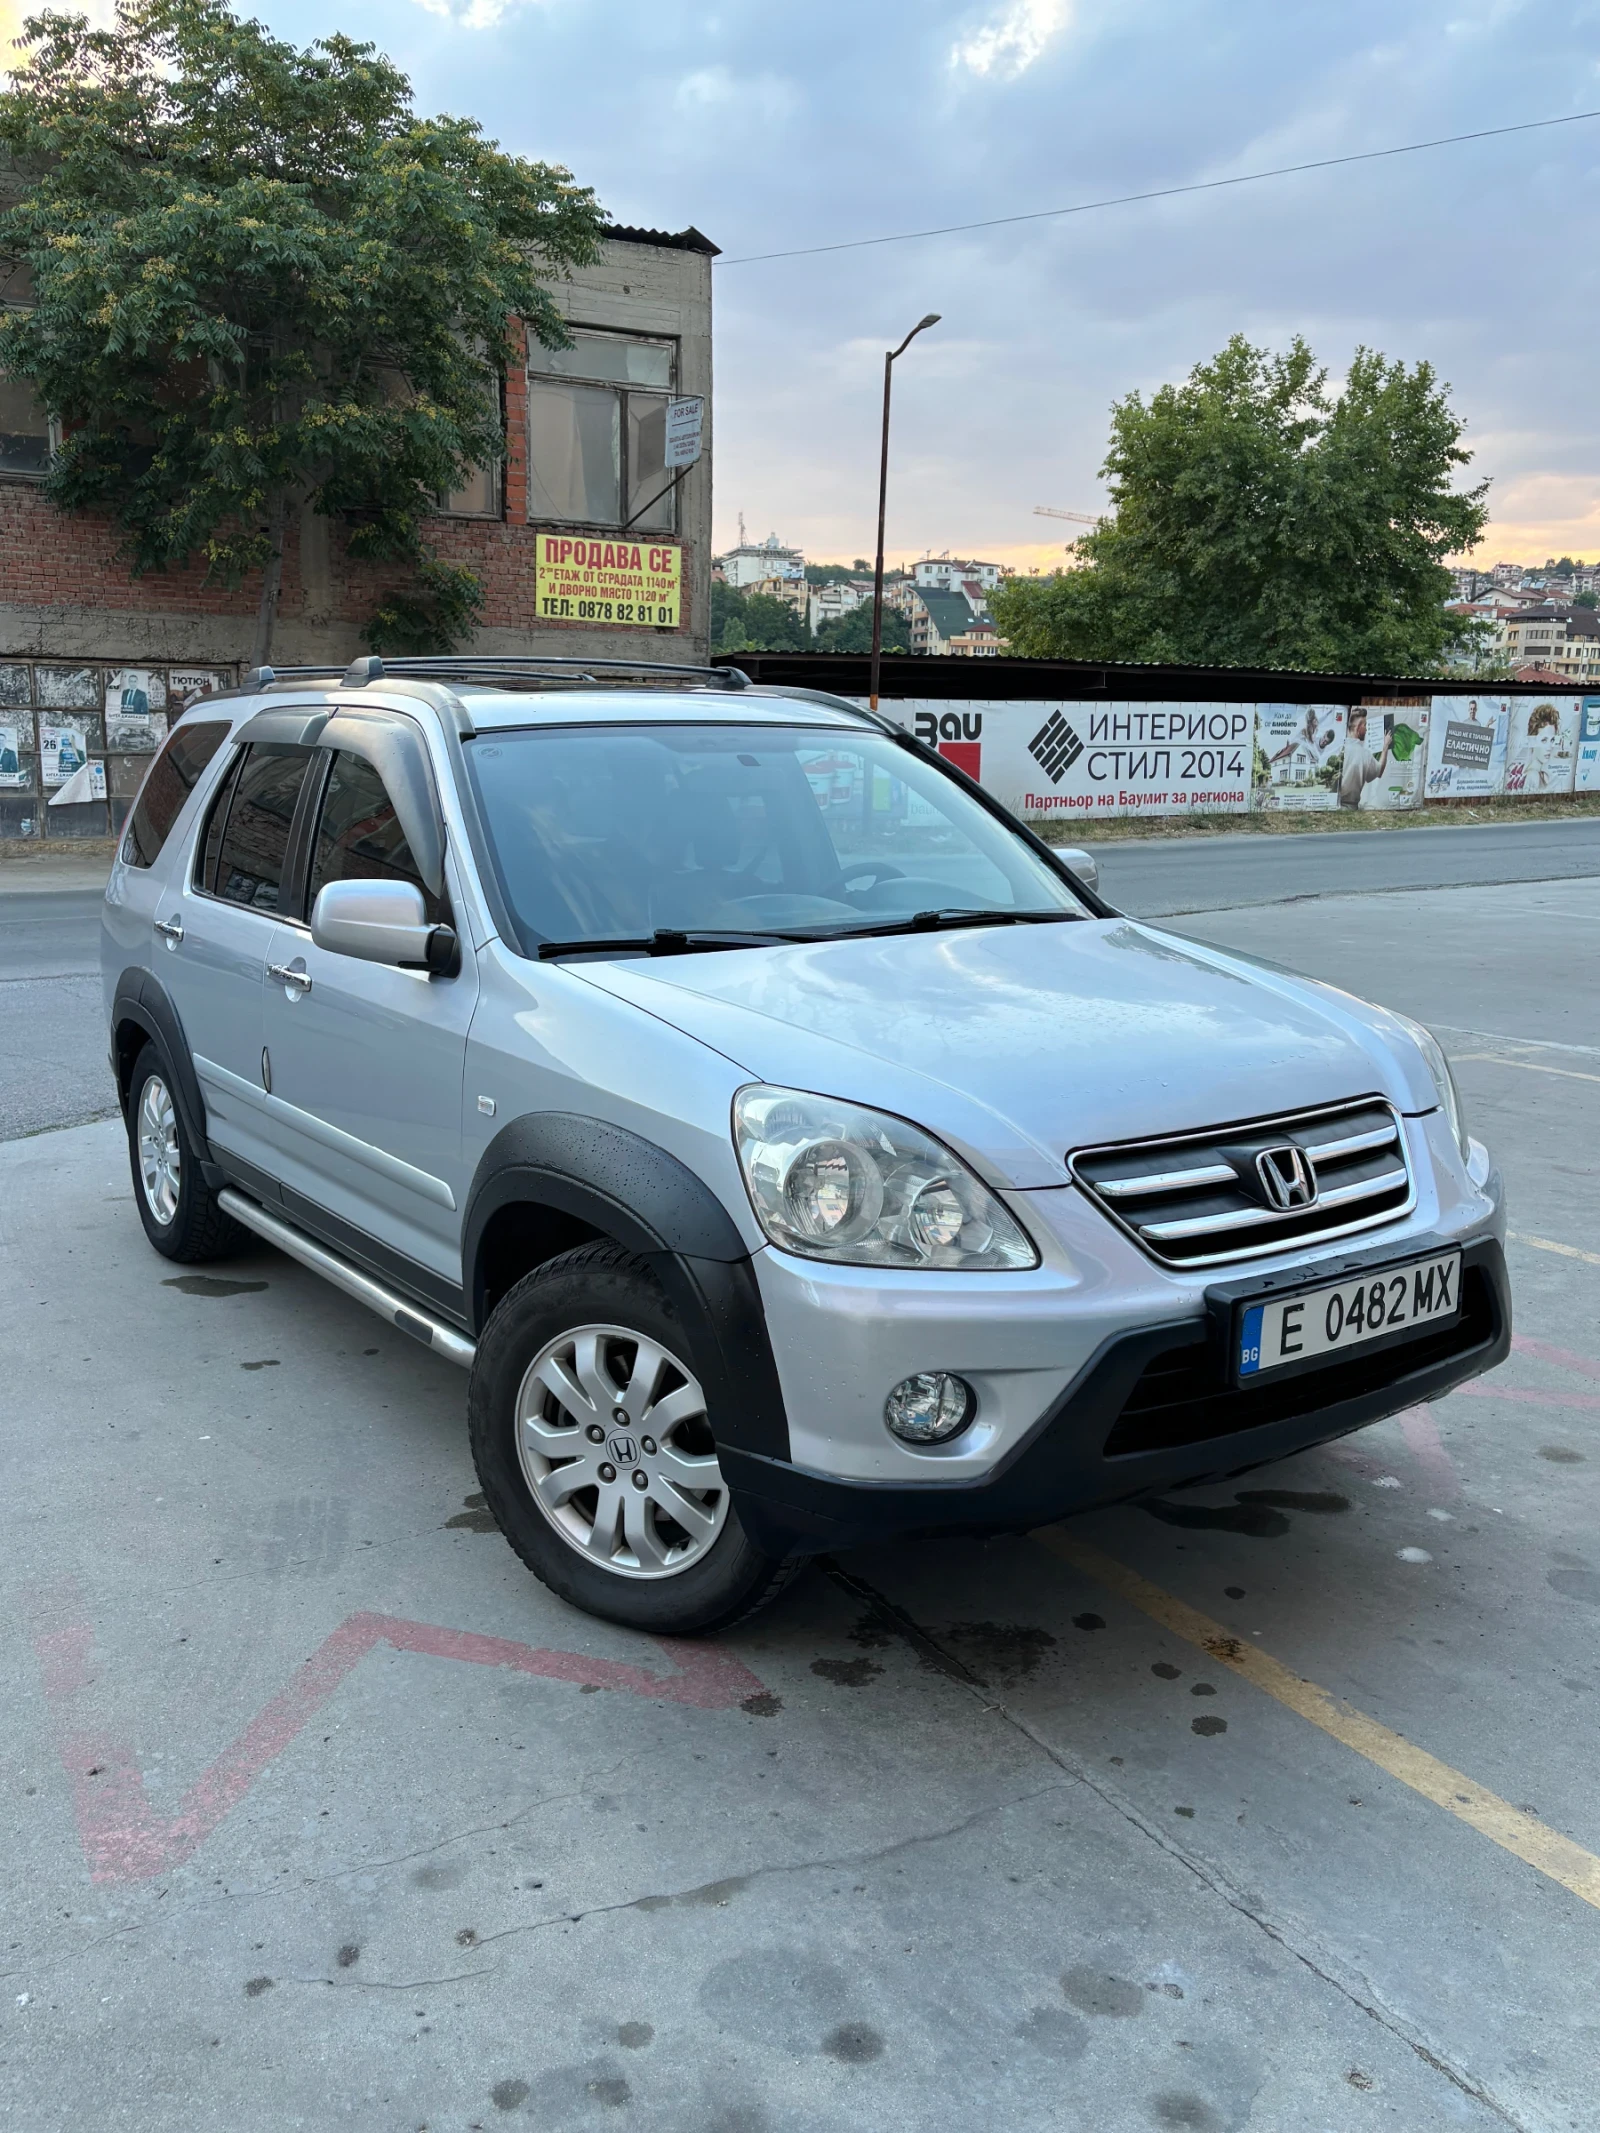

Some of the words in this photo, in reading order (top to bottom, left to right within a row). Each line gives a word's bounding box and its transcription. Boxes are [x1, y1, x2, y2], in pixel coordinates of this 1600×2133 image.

[674, 408, 684, 418] FOR
[685, 404, 698, 416] SALE
[545, 538, 642, 570] ПРОДАВА
[649, 547, 672, 573] СЕ
[554, 570, 580, 582] ЕТАЖ
[583, 571, 594, 583] ОТ
[597, 572, 643, 587] СГРАДАТА
[646, 576, 666, 589] 1140
[548, 583, 556, 594] И
[558, 583, 597, 597] ДВОРНО
[600, 586, 632, 600] МЯСТО
[635, 590, 656, 602] 1120
[542, 597, 574, 617] ТЕЛ:
[578, 600, 613, 619] 0878
[616, 603, 634, 621] 82
[637, 605, 652, 623] 81
[658, 606, 673, 624] 01
[171, 676, 210, 686] ТЮТЮН
[1089, 712, 1248, 741] ИНТЕРИОР
[43, 739, 57, 750] 26
[1445, 739, 1490, 755] ЕЛАСТИЧНО
[1087, 750, 1171, 781] СТИЛ
[1180, 749, 1245, 779] 2014
[1024, 792, 1093, 812] Партньор
[1097, 795, 1115, 806] на
[1118, 789, 1168, 808] Баумит
[1171, 793, 1187, 804] за
[1190, 791, 1244, 808] региона
[1280, 1302, 1305, 1356] E
[1325, 1275, 1407, 1342] 0482
[1412, 1260, 1455, 1318] MX
[1241, 1346, 1259, 1364] BG
